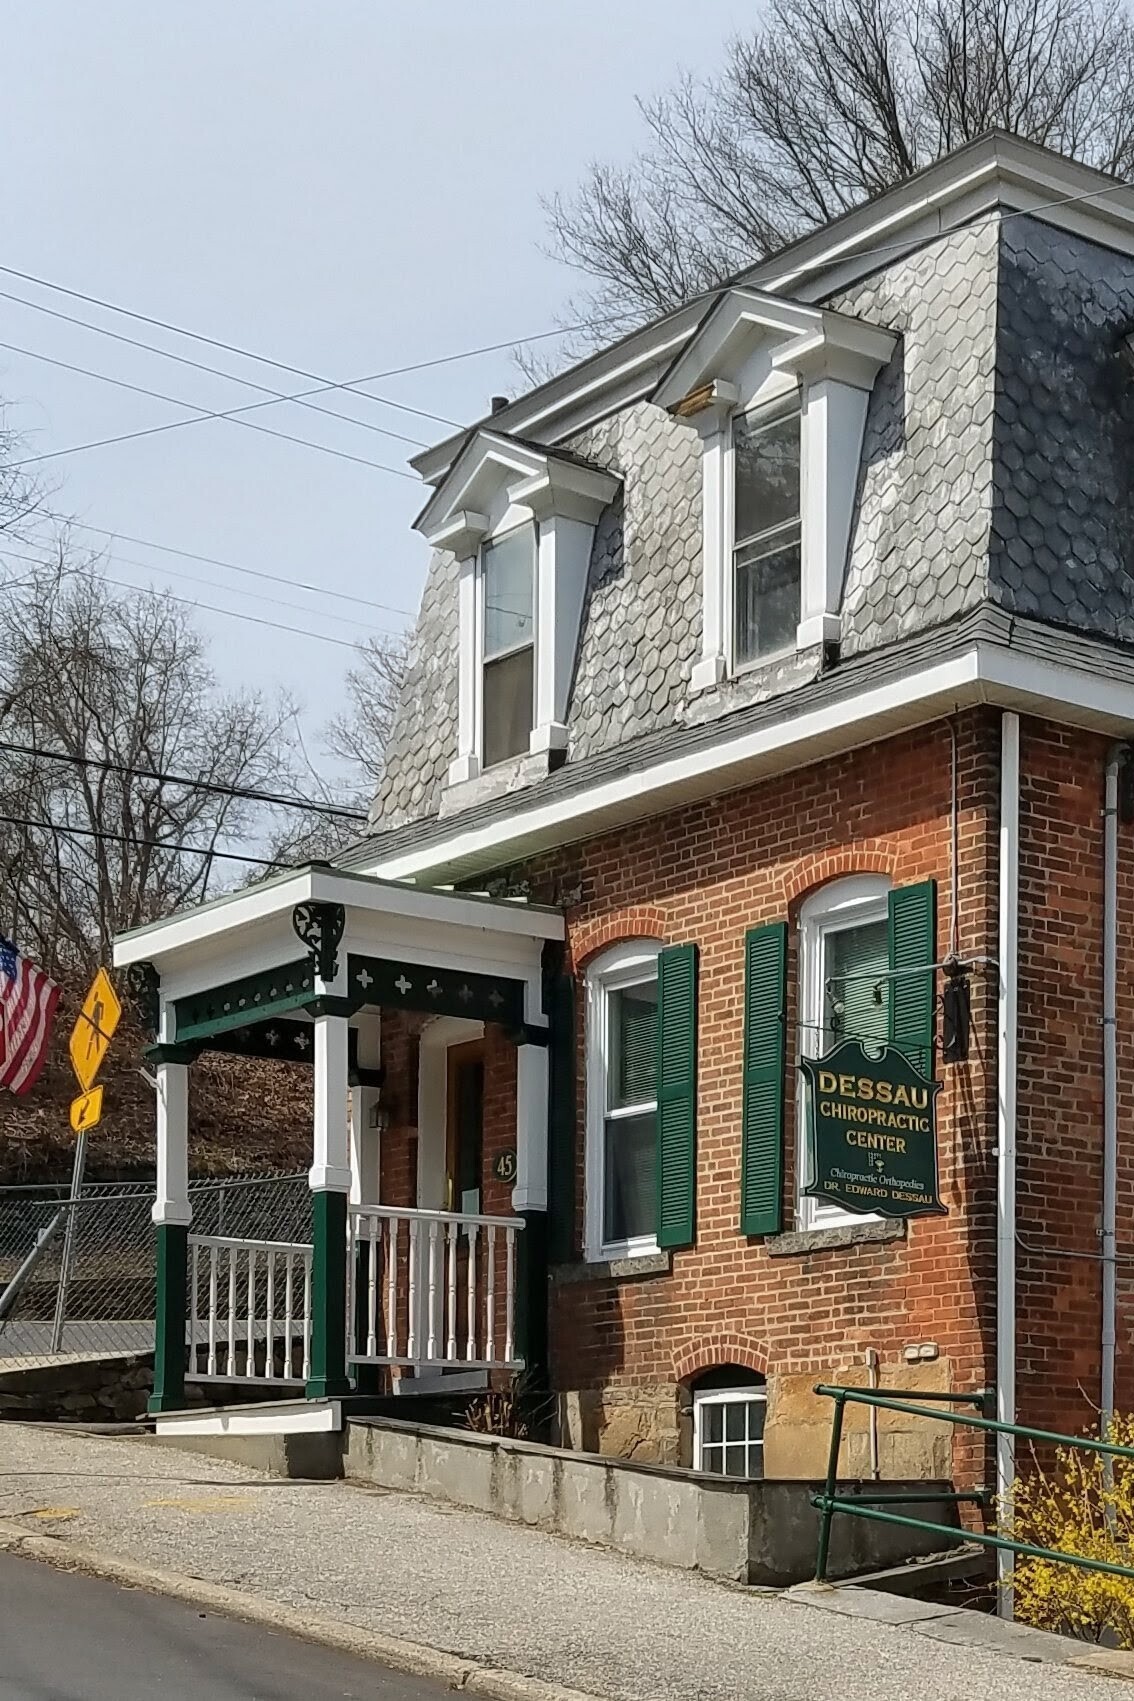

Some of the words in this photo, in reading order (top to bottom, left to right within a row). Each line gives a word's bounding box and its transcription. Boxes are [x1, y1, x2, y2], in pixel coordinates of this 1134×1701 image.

[818, 1071, 928, 1109] DESSAU
[820, 1101, 930, 1132] CHIROPRACTIC
[846, 1130, 906, 1153] CENTER
[497, 1154, 512, 1175] 45
[830, 1168, 877, 1183] Chiropractic
[824, 1181, 840, 1192] DR.
[845, 1184, 888, 1198] EDWARD
[892, 1190, 933, 1204] DESSAU
